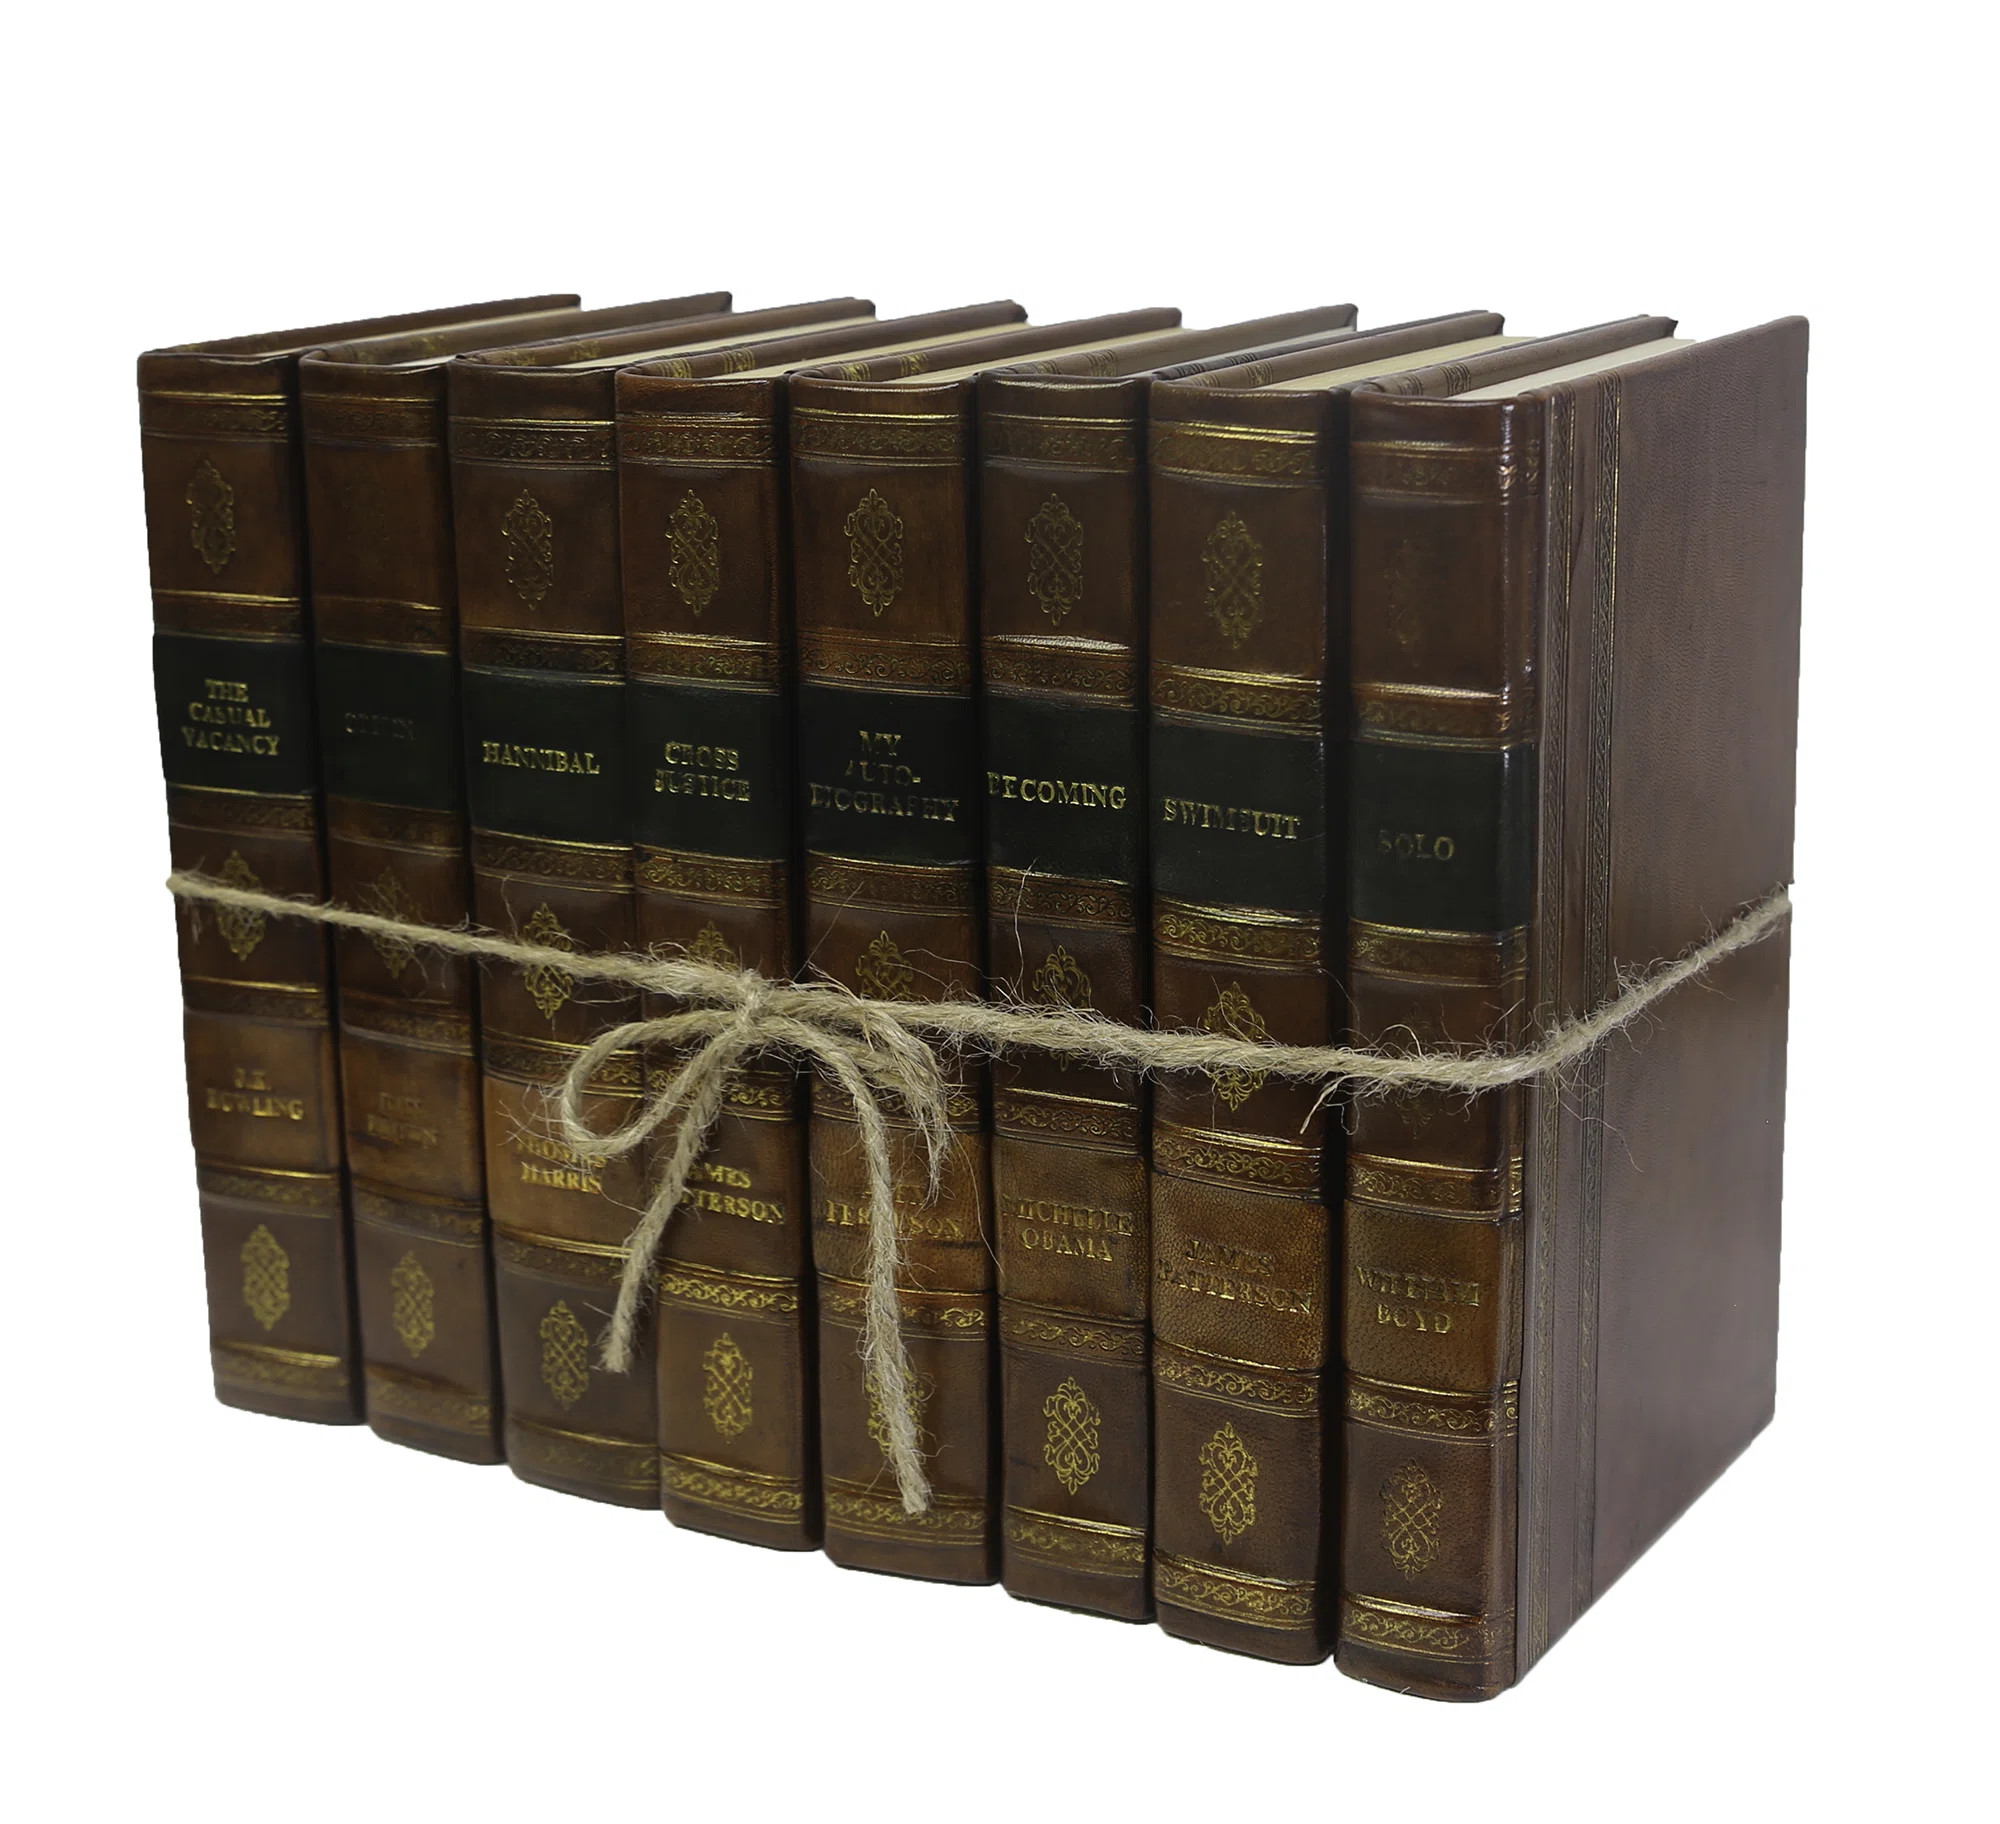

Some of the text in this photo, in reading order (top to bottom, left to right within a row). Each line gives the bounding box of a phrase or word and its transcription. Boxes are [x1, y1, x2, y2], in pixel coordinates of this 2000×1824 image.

[205, 679, 248, 702] THE
[188, 702, 271, 728] CASUAL
[181, 726, 280, 756] VACANCY
[664, 741, 740, 771] CROSS
[859, 730, 901, 756] MY
[482, 740, 600, 775] HANNIBAL
[655, 769, 751, 802] JUSTICE
[986, 771, 1127, 810] BECOMING
[1378, 829, 1455, 861] SOLO
[521, 1162, 602, 1196] HARRIS
[1021, 1227, 1113, 1262] OBAMA
[1376, 1302, 1452, 1334] BOYD
